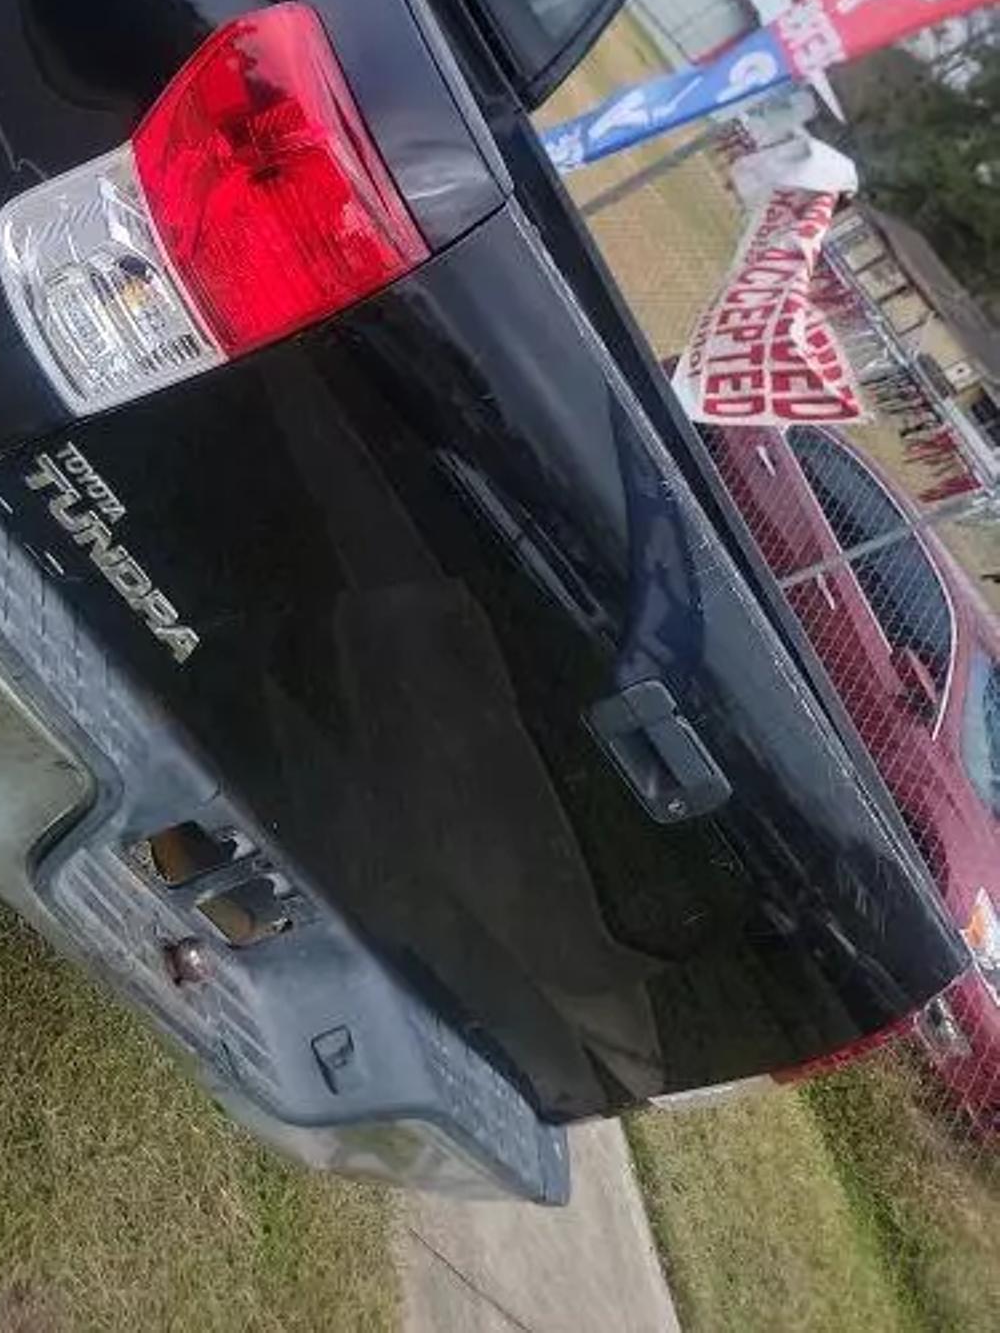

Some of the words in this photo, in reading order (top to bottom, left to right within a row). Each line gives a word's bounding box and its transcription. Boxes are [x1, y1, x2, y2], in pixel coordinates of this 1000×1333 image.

[703, 247, 806, 417] ACCEPTED
[26, 452, 200, 664] TUNDRA
[56, 441, 127, 524] TOYOTA
